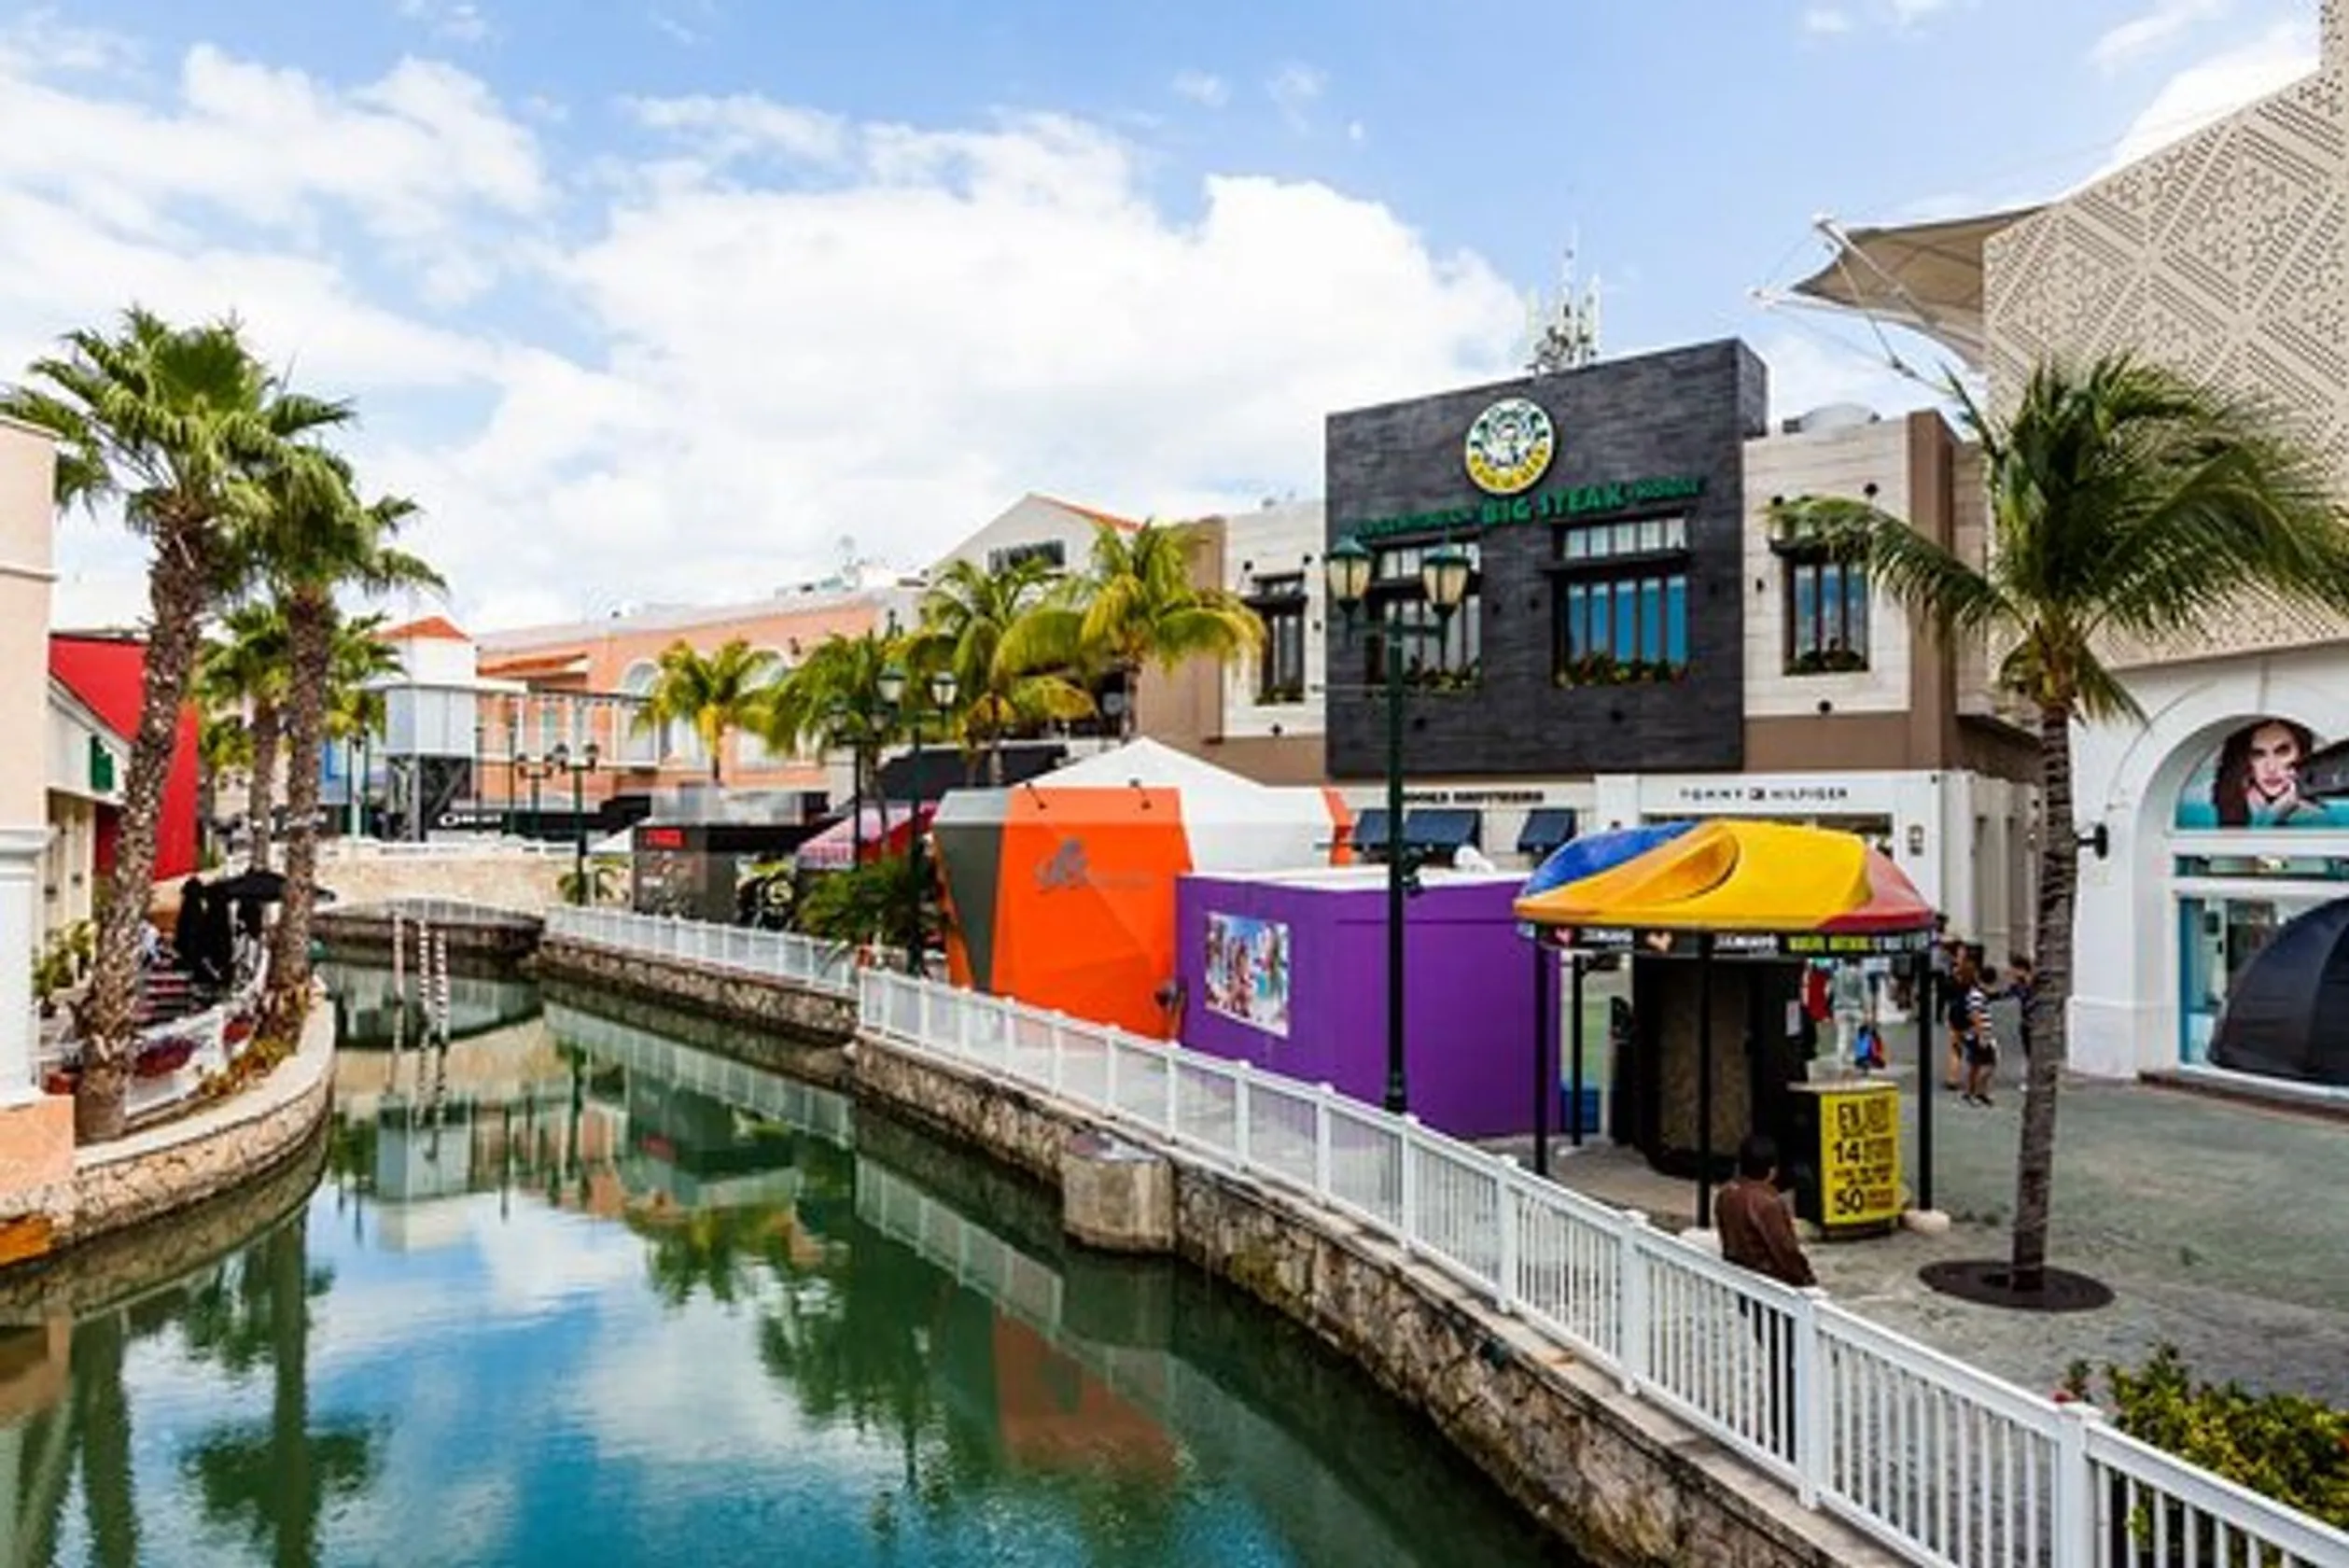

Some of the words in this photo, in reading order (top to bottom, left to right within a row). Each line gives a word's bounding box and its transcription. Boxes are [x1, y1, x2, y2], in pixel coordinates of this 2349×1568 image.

[1482, 497, 1531, 525] BIG
[1538, 482, 1626, 515] STEAK
[1833, 1141, 1861, 1165] 14
[1834, 1187, 1865, 1215] 50
